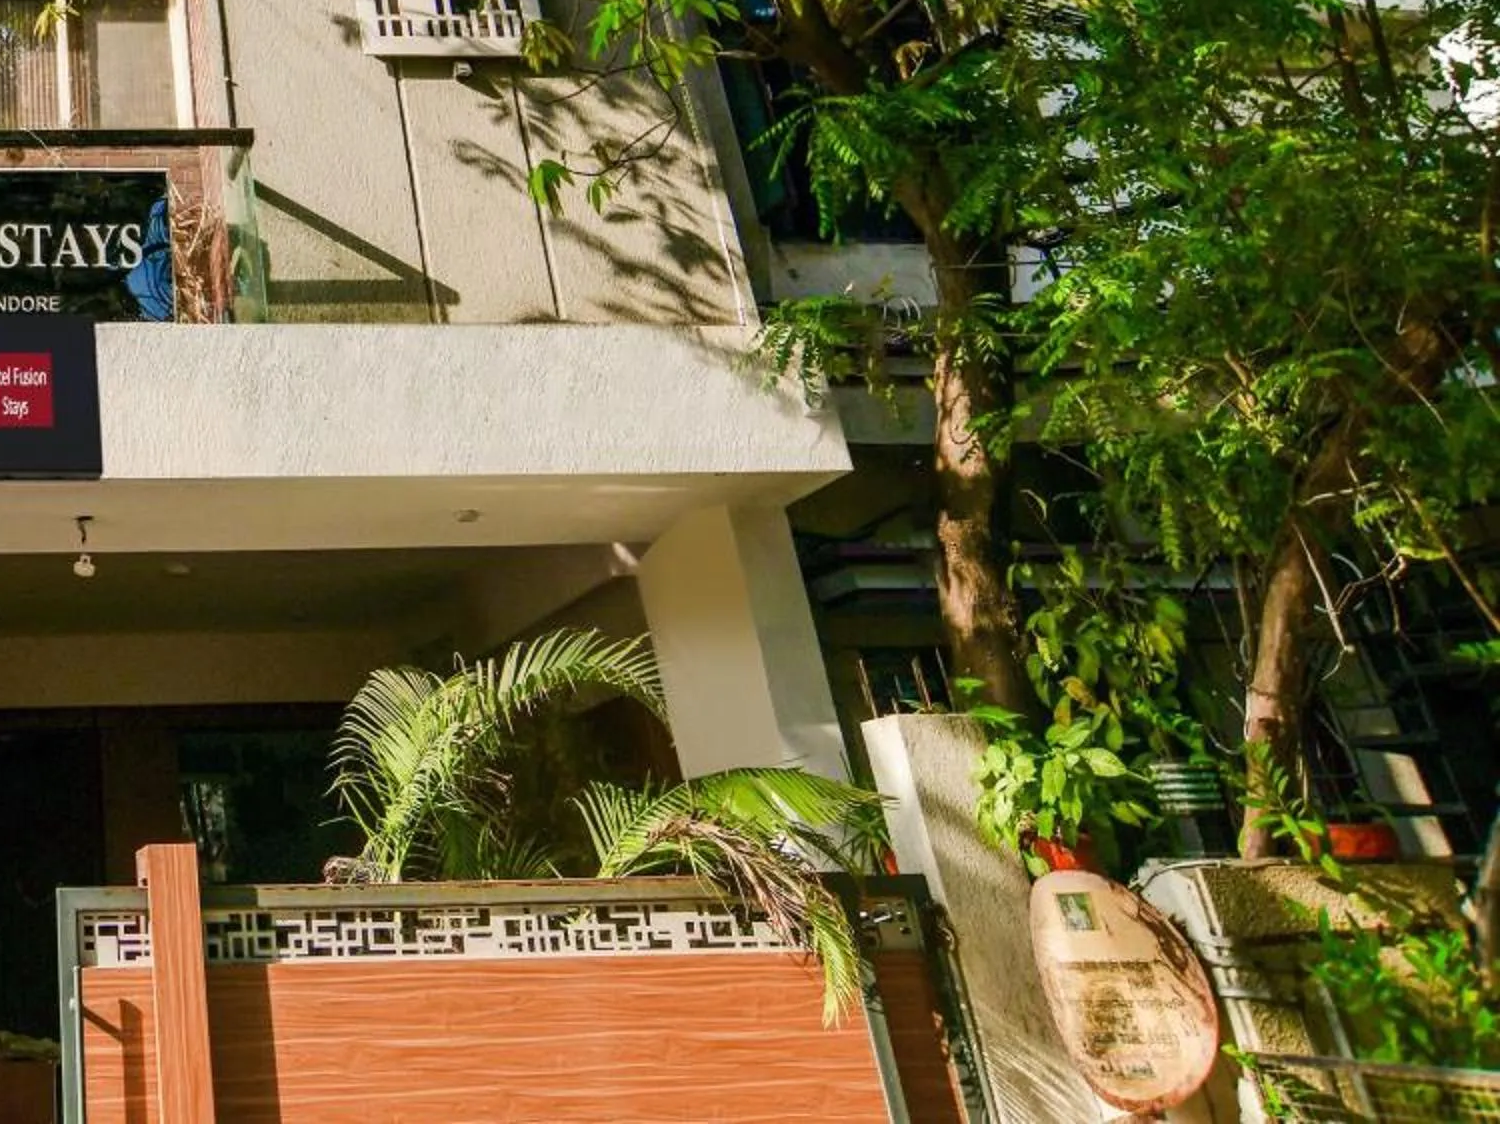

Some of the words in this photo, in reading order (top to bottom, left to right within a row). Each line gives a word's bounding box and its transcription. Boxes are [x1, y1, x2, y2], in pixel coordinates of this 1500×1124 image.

[0, 223, 143, 269] STAYS
[13, 367, 47, 386] Fusion
[2, 396, 29, 419] Stays
